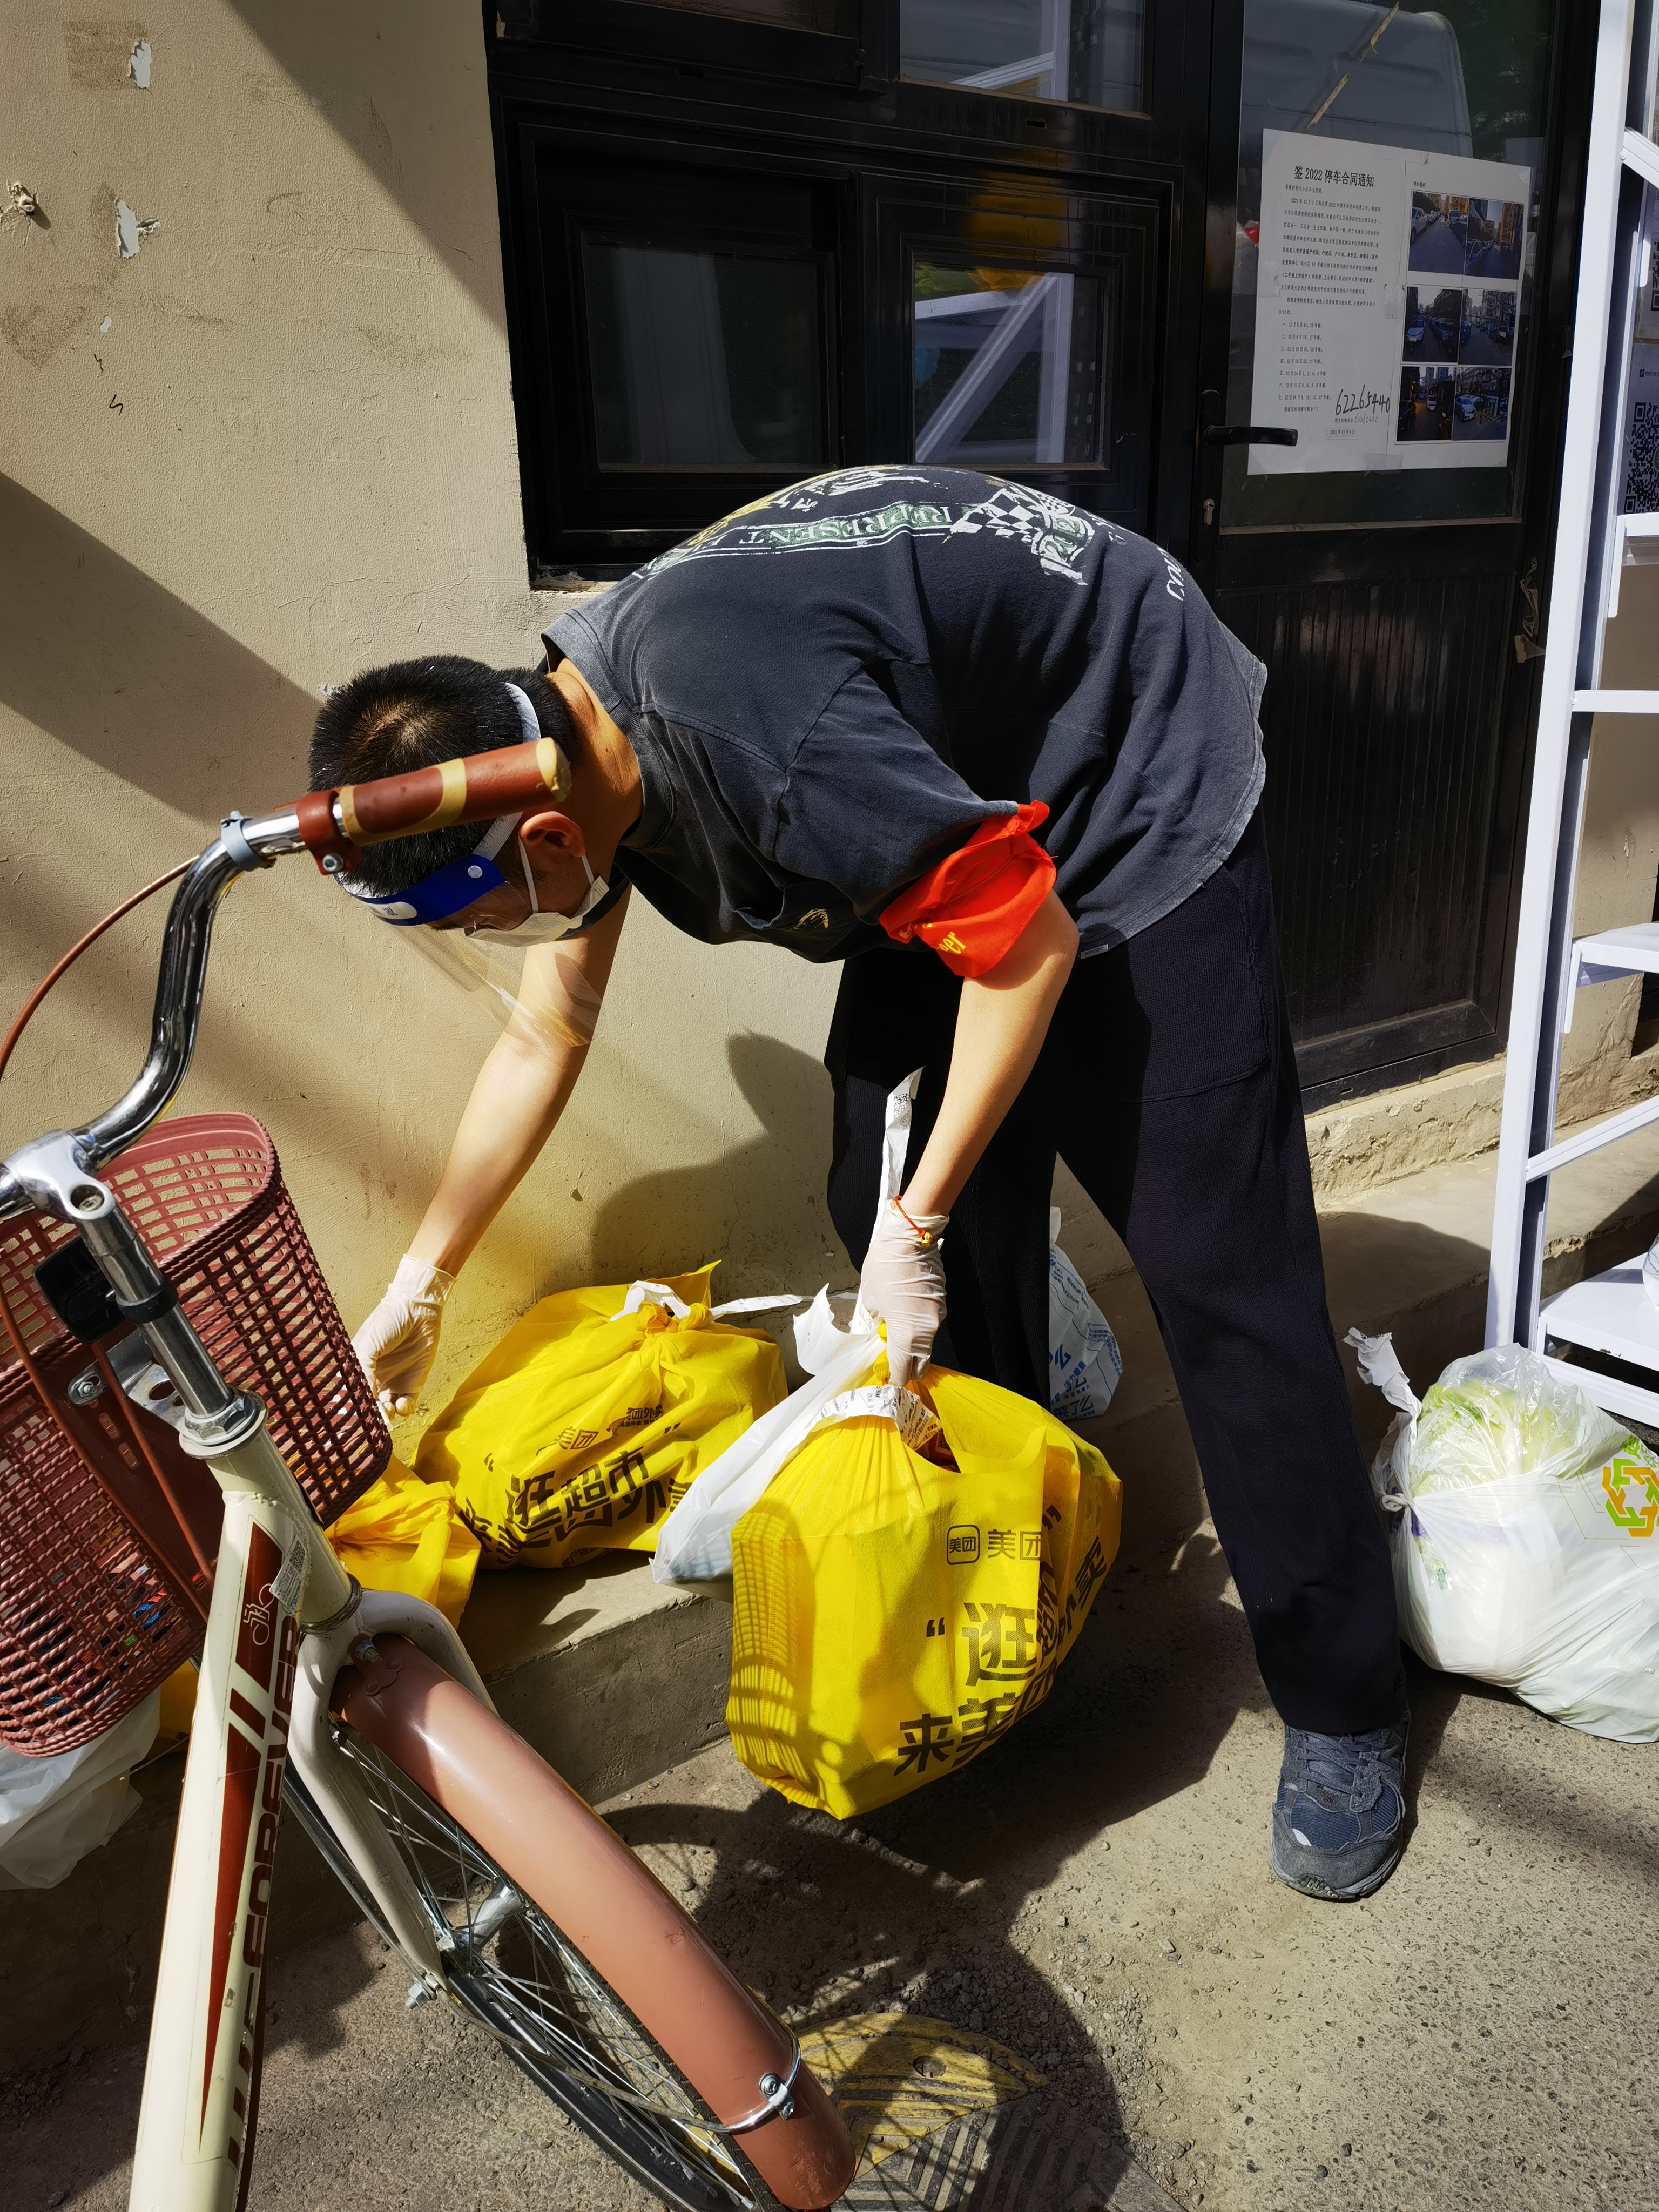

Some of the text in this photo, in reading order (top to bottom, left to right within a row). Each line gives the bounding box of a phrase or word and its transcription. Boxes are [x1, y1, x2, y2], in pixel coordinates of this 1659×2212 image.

[1294, 164, 1374, 188] 签 2022 停车合同通知
[1336, 384, 1391, 415] 62265440
[739, 504, 951, 546] REPRESENT
[949, 1527, 1041, 1561] 美团 美团
